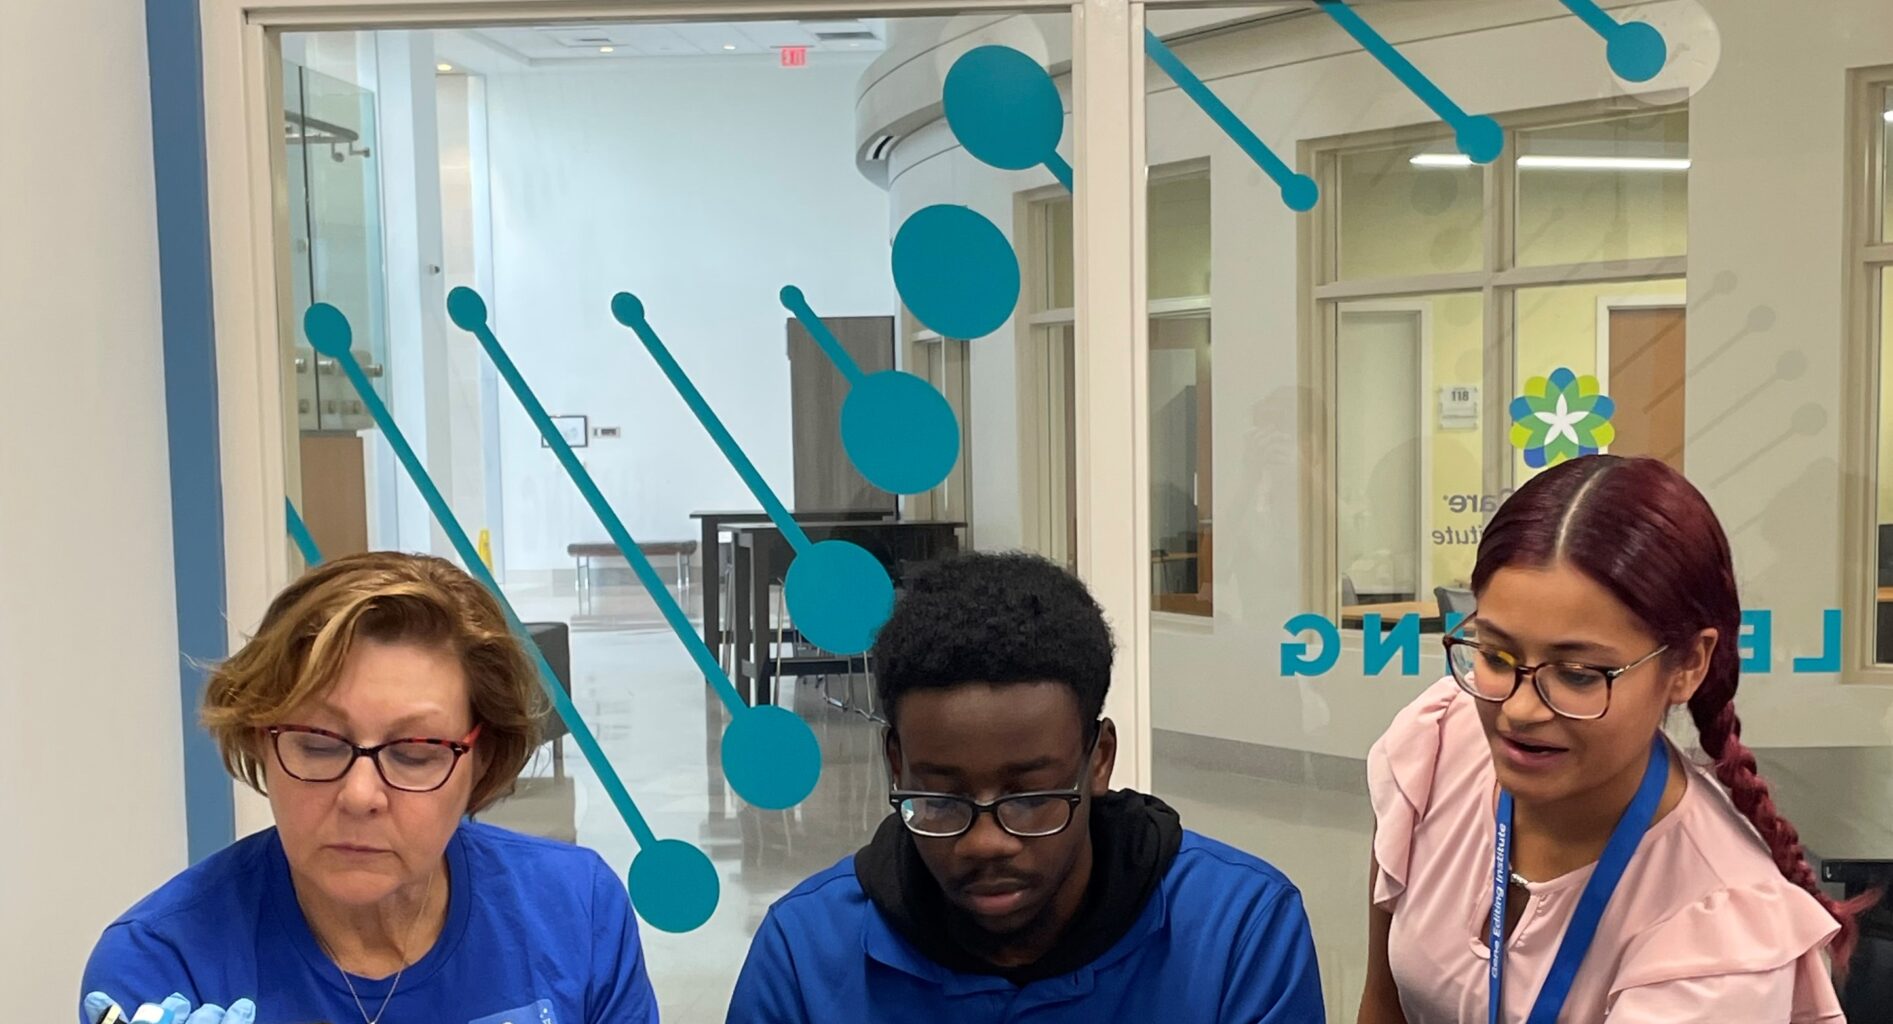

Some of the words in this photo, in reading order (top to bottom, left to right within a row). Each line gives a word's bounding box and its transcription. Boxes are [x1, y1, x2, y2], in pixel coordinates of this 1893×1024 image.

[1451, 391, 1469, 401] 118
[1496, 823, 1507, 884] Institute
[1493, 886, 1504, 938] Editing
